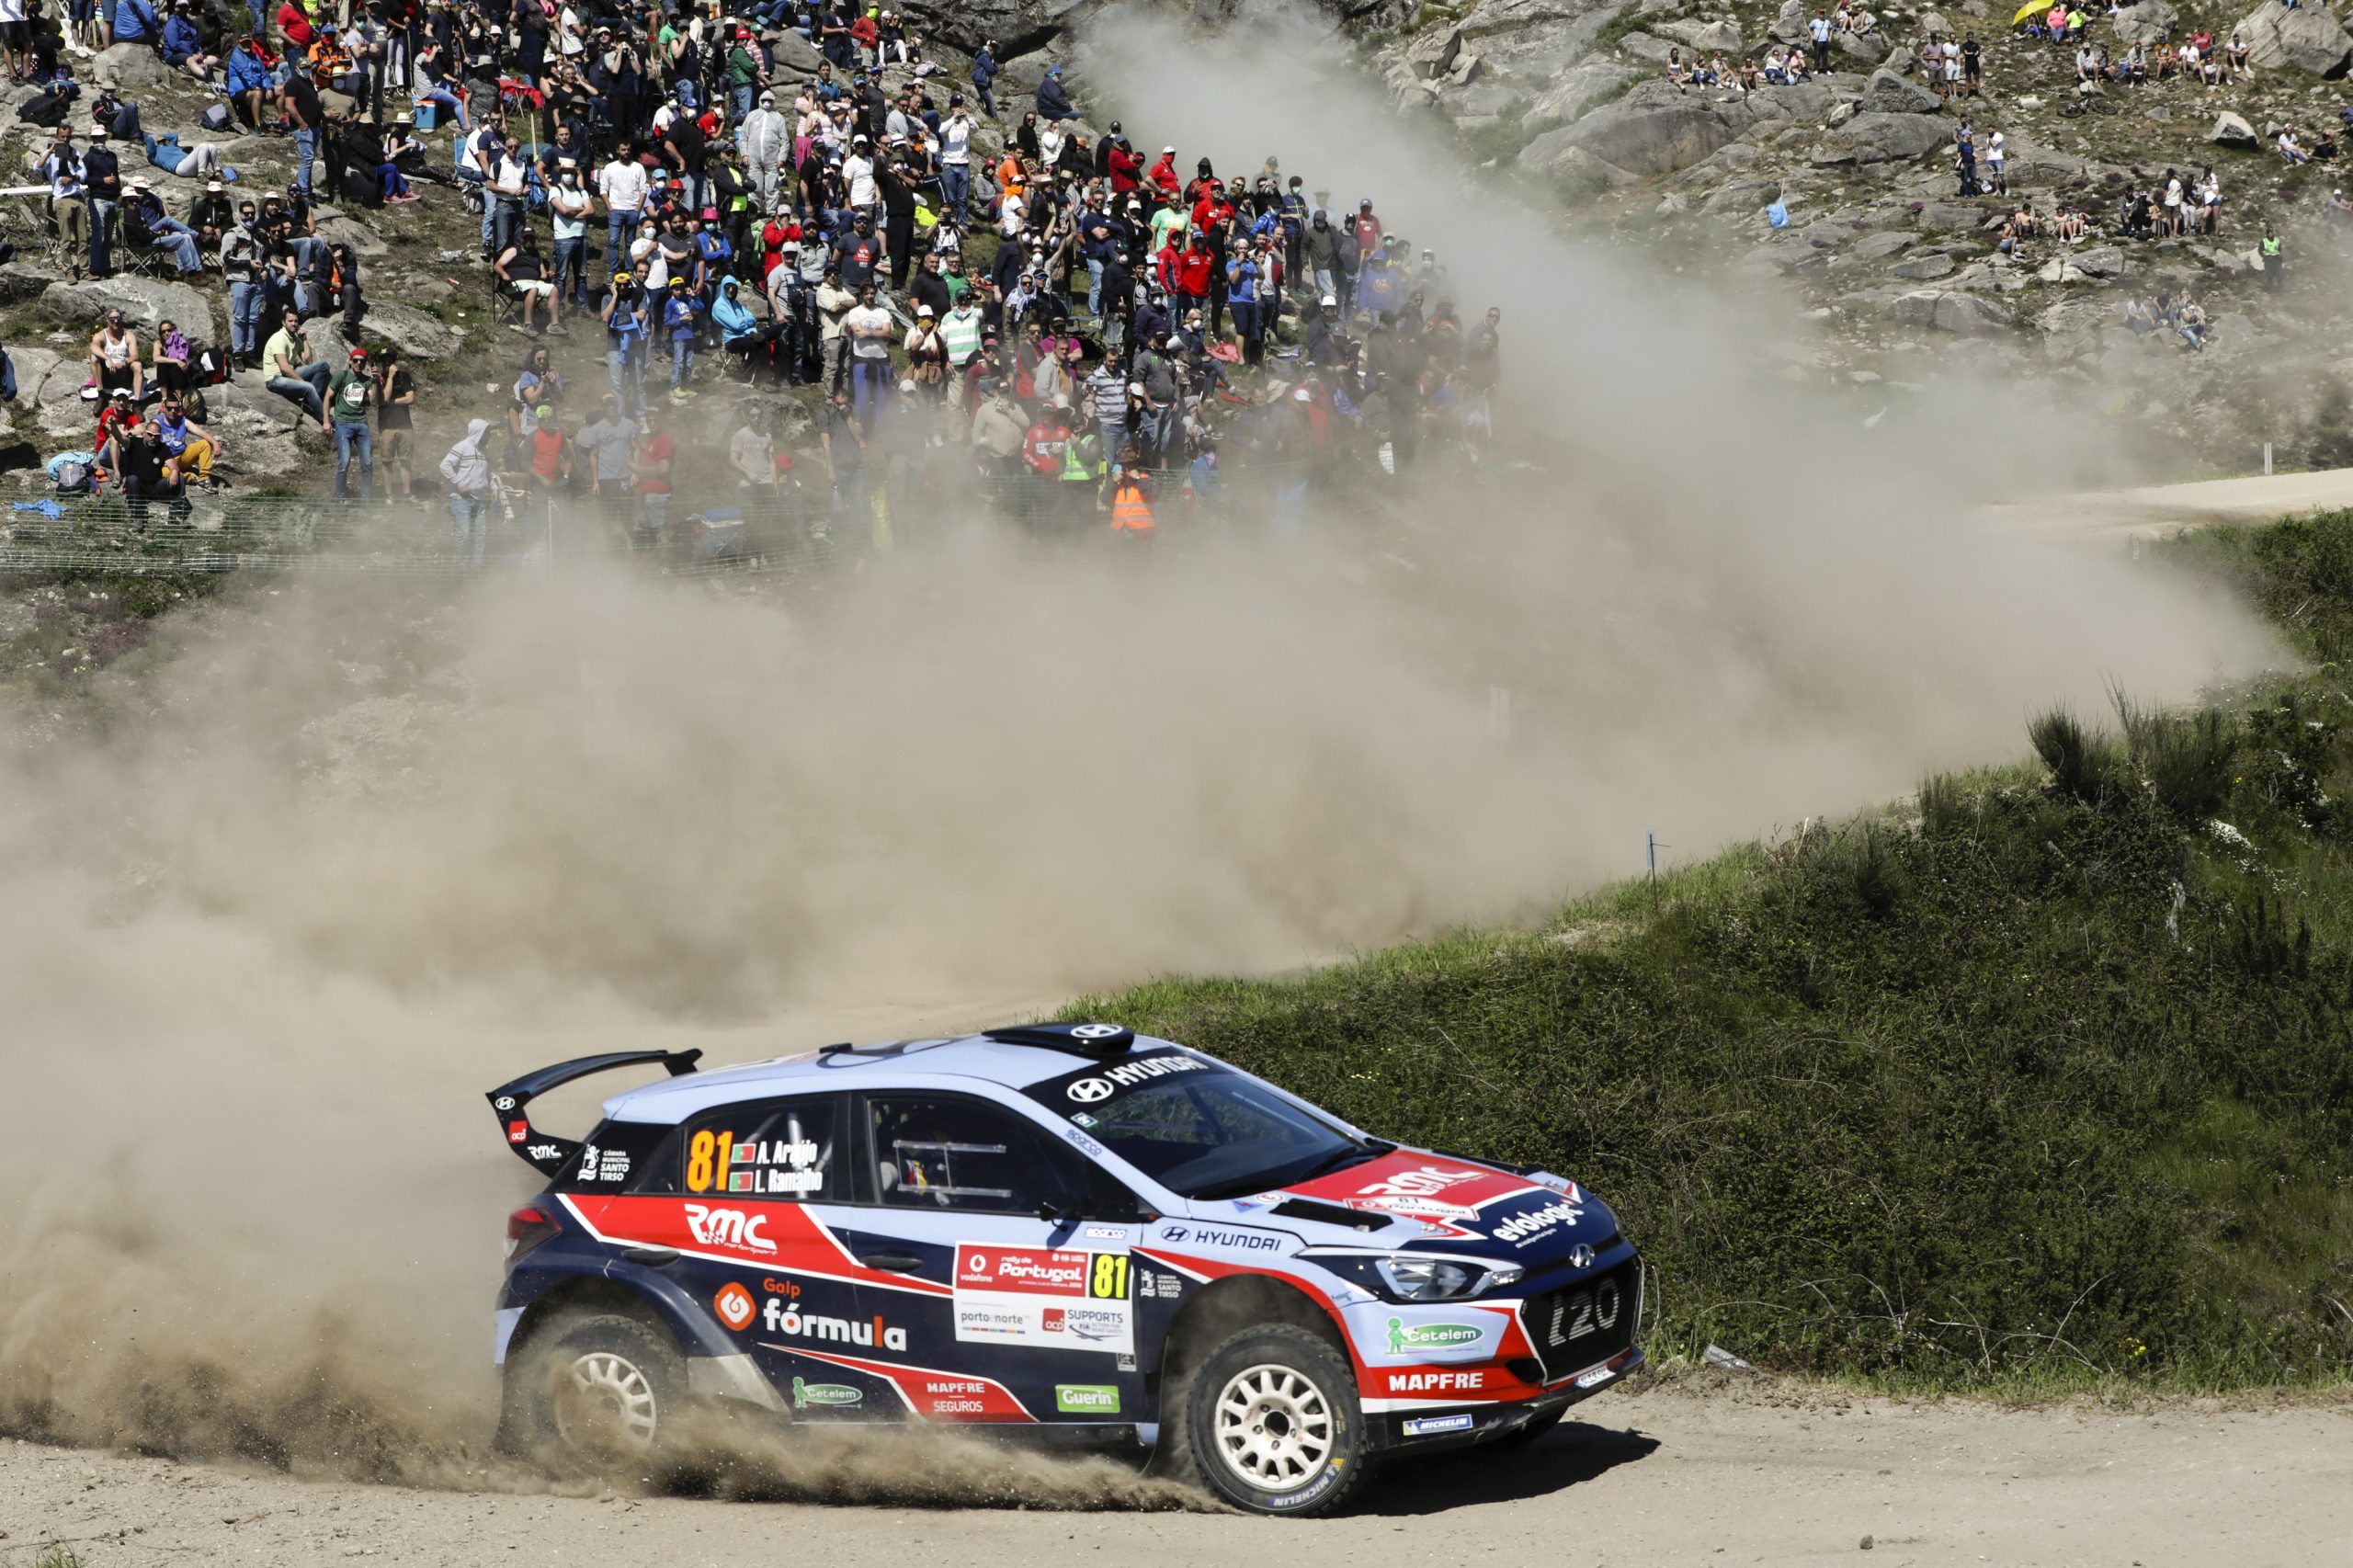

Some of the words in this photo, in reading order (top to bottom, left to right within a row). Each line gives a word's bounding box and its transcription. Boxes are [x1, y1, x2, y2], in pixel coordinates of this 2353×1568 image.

[1105, 1056, 1209, 1086] HYUNDAI
[756, 1141, 770, 1165] A.
[773, 1139, 818, 1166] Araújo
[1067, 1130, 1102, 1155] sparco
[600, 1164, 630, 1173] SANTO
[687, 1130, 733, 1192] 81
[599, 1172, 624, 1181] TIRSO
[768, 1168, 823, 1193] Ramalho
[1195, 1231, 1281, 1251] HYUNDAI
[1001, 1256, 1020, 1265] rally
[960, 1273, 994, 1283] vodafone
[998, 1262, 1083, 1282] Portugal
[1094, 1255, 1128, 1299] 81
[763, 1278, 801, 1300] Galp
[763, 1298, 907, 1351] fórmula
[1067, 1309, 1123, 1324] SUPPORTS
[1407, 1329, 1477, 1342] Cetelem
[926, 1382, 985, 1393] MAPFRE
[1388, 1372, 1483, 1392] MAPFRE
[1062, 1389, 1112, 1404] Guerin
[933, 1401, 983, 1413] SEGUROS
[1419, 1417, 1468, 1430] MICHELIN
[1273, 1476, 1329, 1506] MICHELIN
